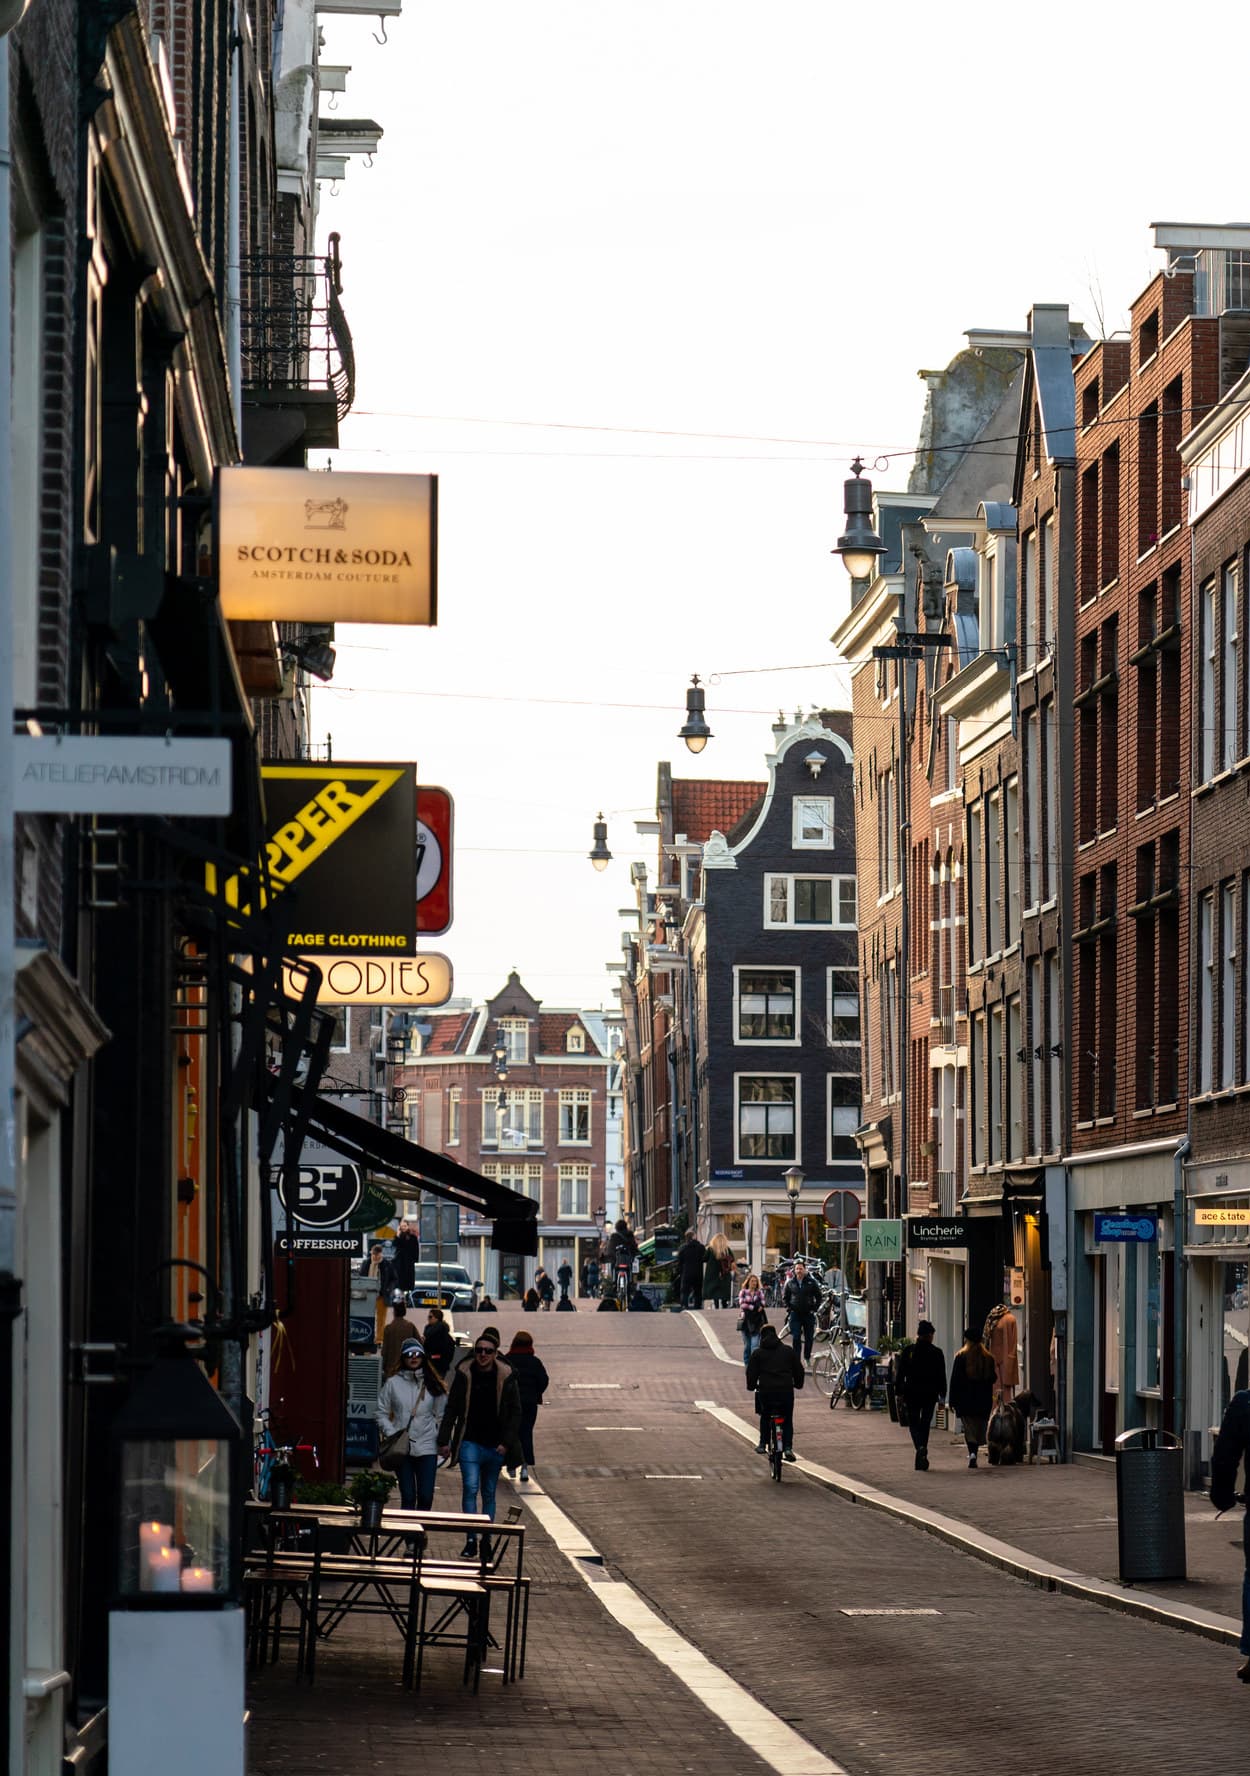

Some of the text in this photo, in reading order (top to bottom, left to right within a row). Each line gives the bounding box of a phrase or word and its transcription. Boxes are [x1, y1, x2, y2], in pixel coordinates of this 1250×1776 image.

[252, 570, 400, 584] AMSTERDAM COUTURE
[329, 934, 408, 947] CLOTHING
[1201, 1212, 1246, 1220] ace & tate
[913, 1225, 964, 1236] Lincherie
[865, 1235, 897, 1247] RAIN
